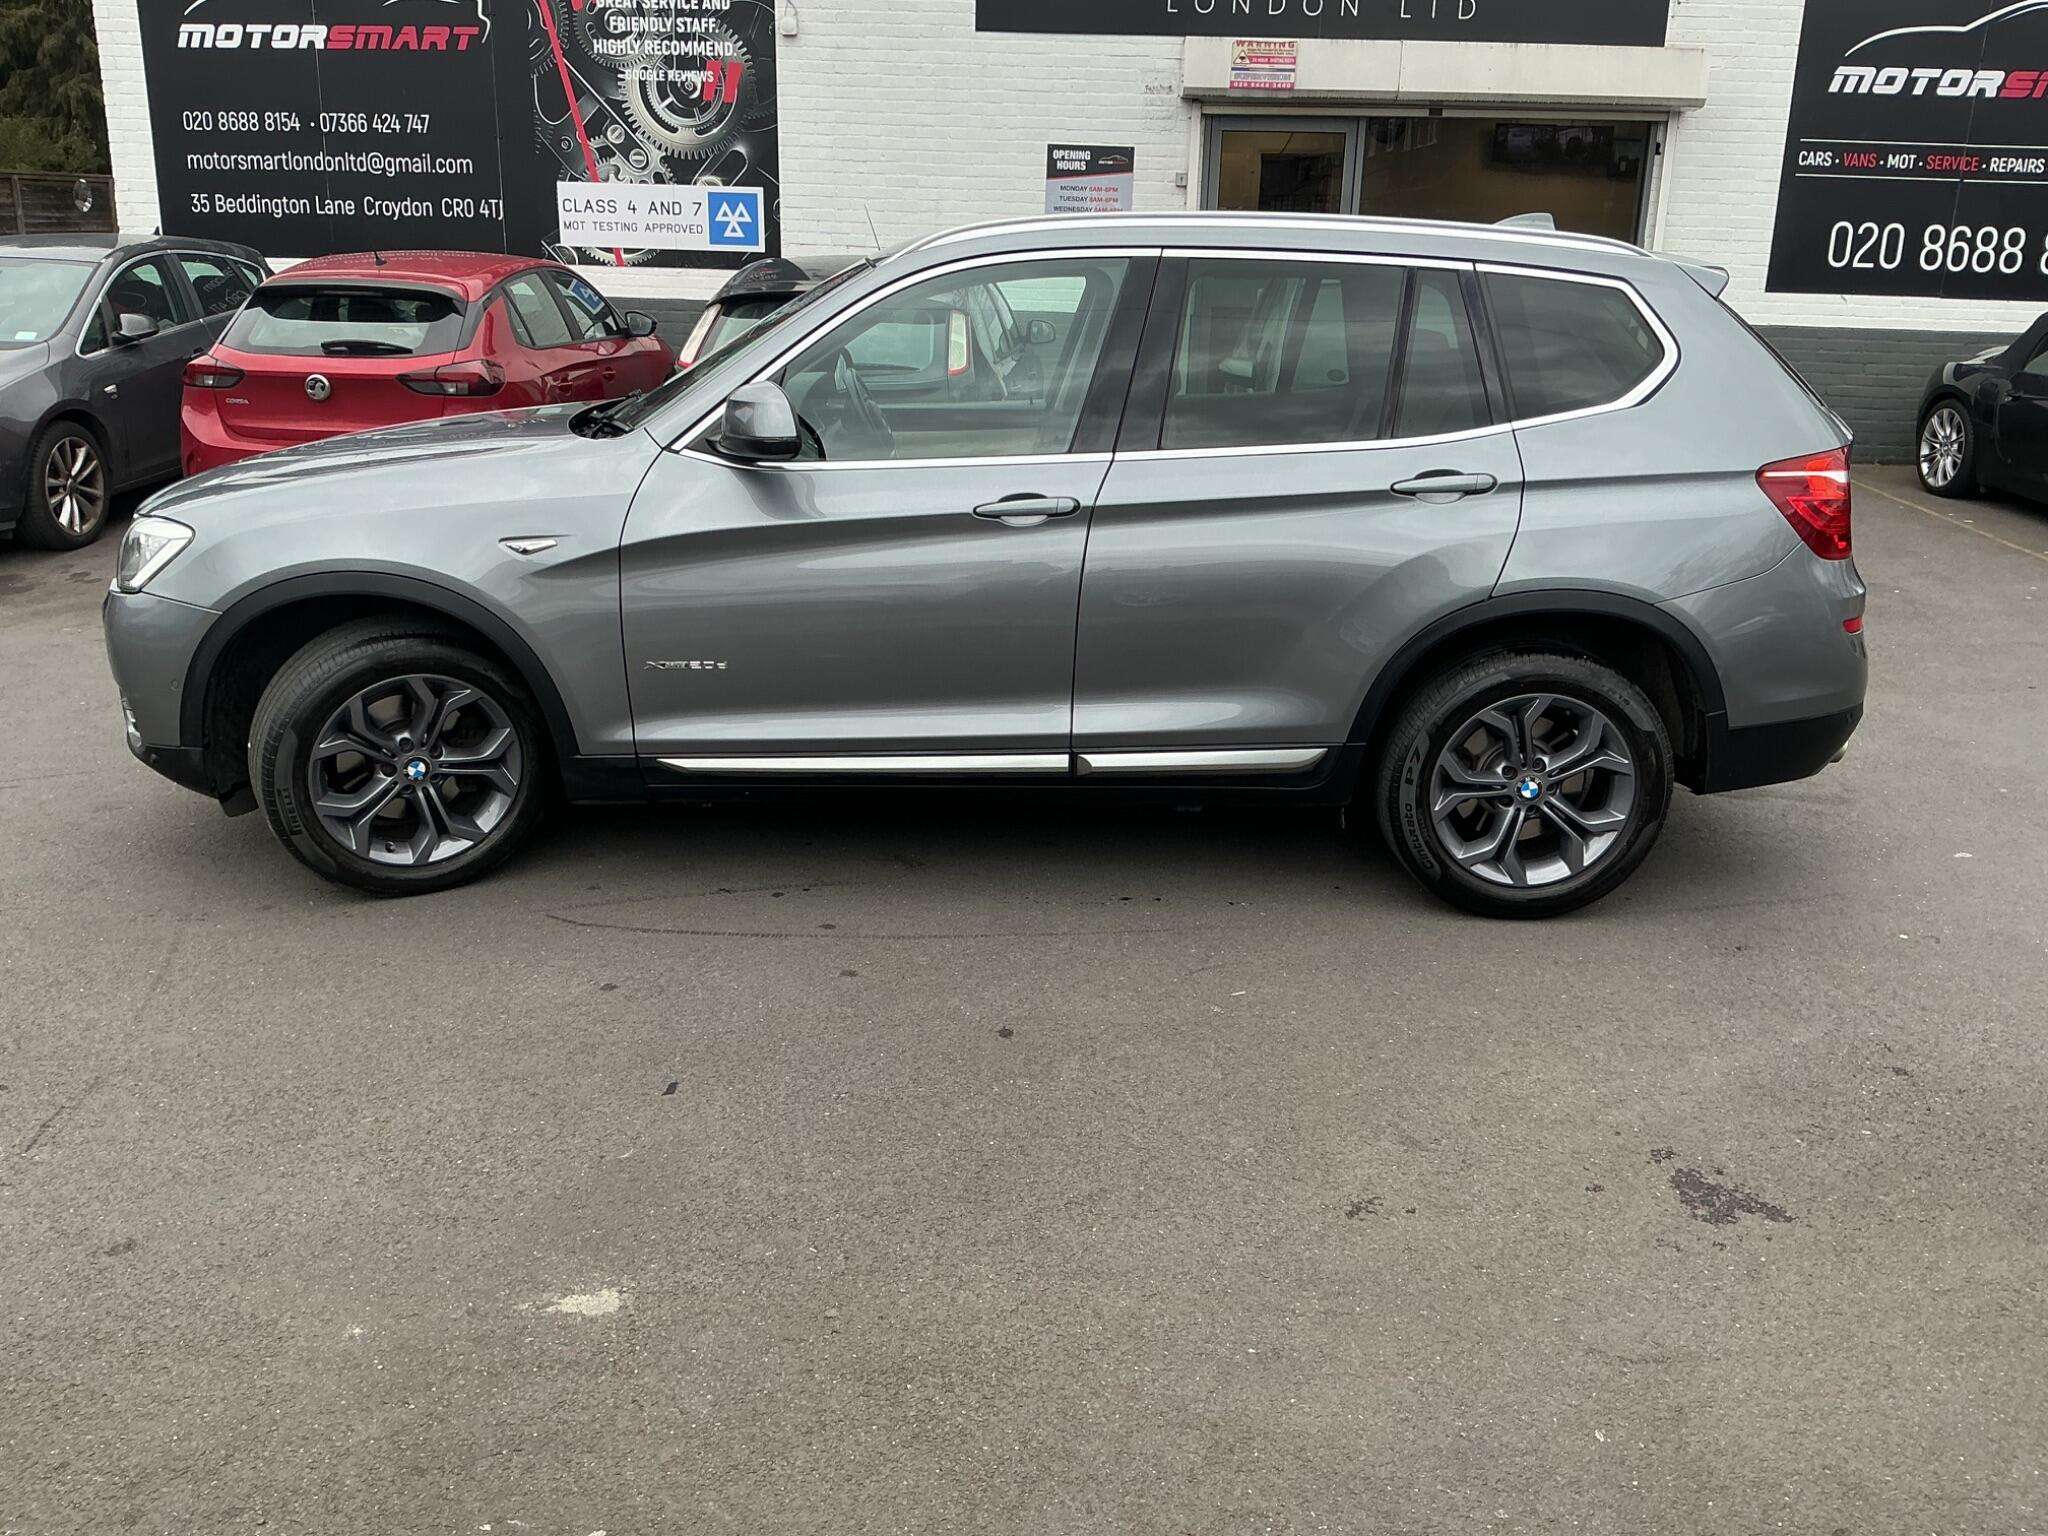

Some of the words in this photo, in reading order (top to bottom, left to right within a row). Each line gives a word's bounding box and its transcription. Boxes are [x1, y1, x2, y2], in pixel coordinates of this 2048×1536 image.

[641, 0, 699, 10] SERVICE
[702, 0, 731, 11] AND
[609, 16, 673, 33] FRIENDLY
[676, 17, 719, 33] STAFF.
[177, 23, 480, 51] MOTORSMART
[1235, 40, 1295, 48] WARNING
[592, 38, 640, 55] HIGHLY
[644, 40, 738, 57] RECOMMEND.
[624, 70, 664, 81] GOOGLE
[667, 70, 714, 82] REVIEWS
[1828, 65, 2048, 99] MOTORS
[182, 110, 213, 131] 020
[217, 111, 260, 132] 8688
[264, 111, 301, 132] 8154
[319, 112, 368, 133] 07366
[372, 113, 401, 133] 424
[404, 113, 431, 134] 747
[187, 150, 473, 177] motorsmartlondonltd@gmail.com
[1052, 149, 1091, 161] OPENING
[1798, 150, 1832, 167] CARS
[1843, 152, 1877, 169] VANS
[1887, 153, 1917, 170] MOT
[1926, 155, 1980, 172] SERVICE
[1989, 157, 2046, 174] REPAIRS
[1056, 160, 1087, 171] HOURS
[1060, 184, 1088, 192] MONDAY
[191, 193, 210, 213] 35
[214, 193, 311, 218] Beddington
[315, 195, 355, 215] Lane
[363, 196, 433, 221] Croydon
[479, 199, 504, 221] 4TJ
[562, 198, 618, 214] CLASS
[627, 200, 638, 215] 4
[648, 201, 682, 216] AND
[692, 201, 702, 216] 7
[1059, 195, 1088, 203] TUESDAY
[1053, 205, 1093, 213] WEDNESDAY
[563, 220, 586, 231] MOT
[592, 221, 638, 233] TESTING
[644, 223, 704, 236] APPROVED
[1827, 221, 1906, 270] 020
[1919, 224, 2027, 274] 8688
